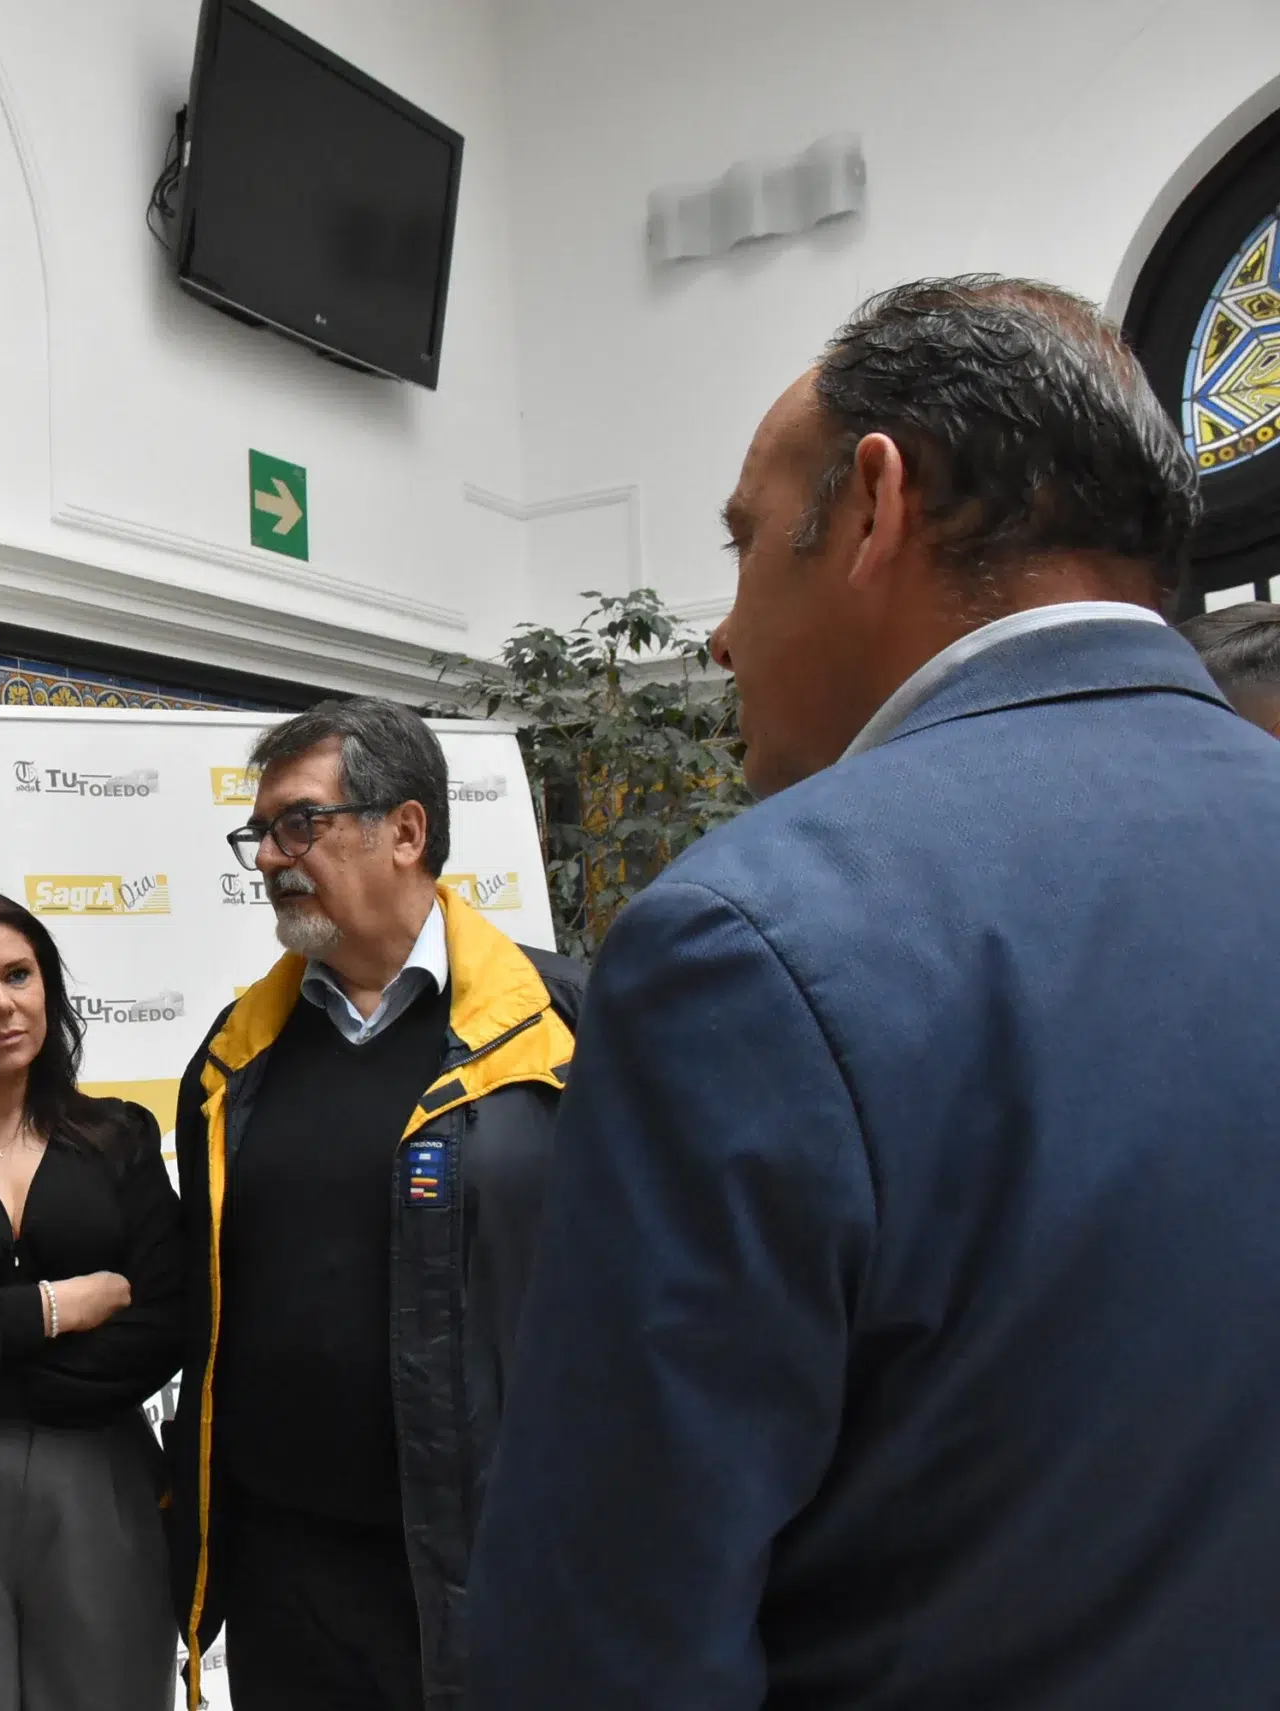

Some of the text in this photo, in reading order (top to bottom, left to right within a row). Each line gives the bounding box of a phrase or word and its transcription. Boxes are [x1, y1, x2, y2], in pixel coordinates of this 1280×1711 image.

[76, 781, 150, 797] TOLEDO
[447, 789, 499, 802] OLEDO
[101, 1007, 176, 1023] TOLEDO
